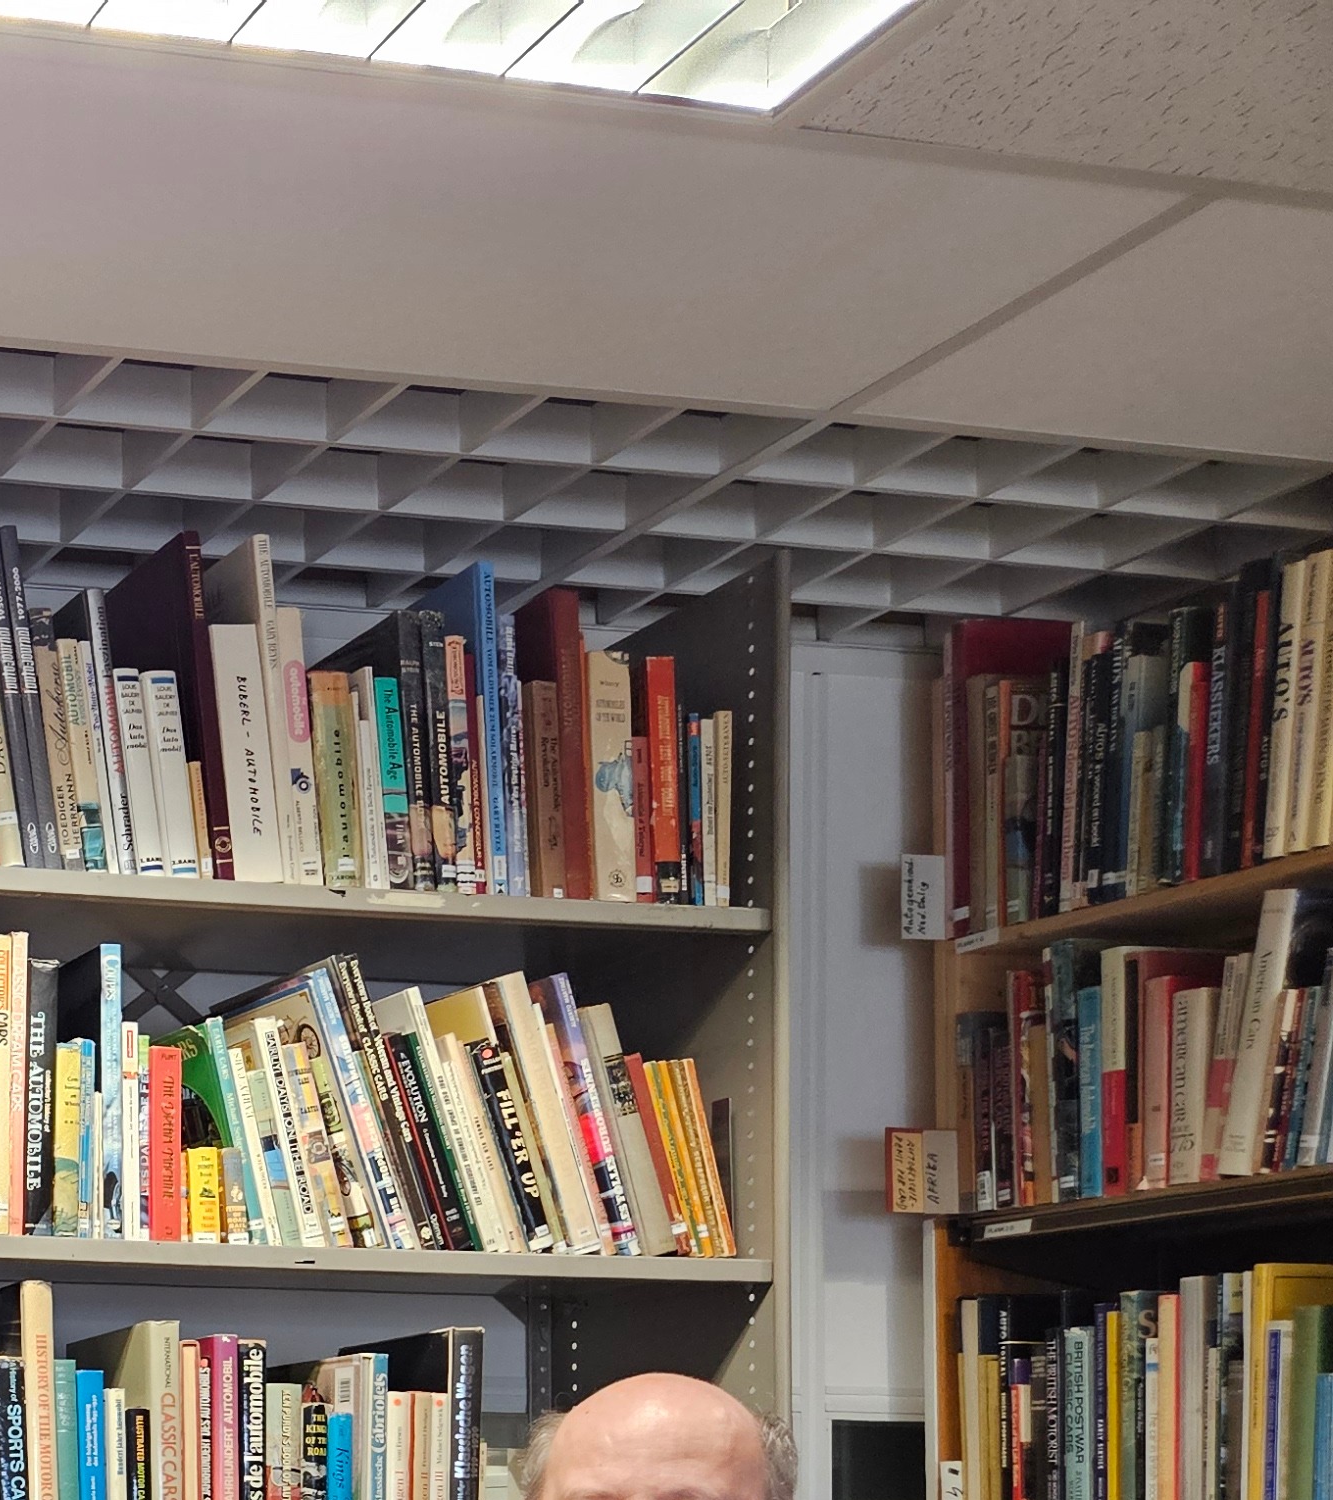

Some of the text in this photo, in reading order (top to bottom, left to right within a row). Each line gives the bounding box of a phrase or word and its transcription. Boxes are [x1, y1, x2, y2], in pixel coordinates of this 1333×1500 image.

[12, 566, 25, 621] 1977-2000
[188, 552, 204, 621] L'AUTOMOBILE
[287, 667, 305, 736] automobile
[1206, 644, 1226, 765] KLASSIEKERS
[1271, 621, 1294, 723] AUTO'S
[236, 675, 252, 725] BUBERL
[245, 748, 262, 837] AUTOMOBILE
[383, 688, 402, 781] The Automobile Age
[435, 710, 451, 804] AUTOMOBILE
[116, 793, 132, 851] Schrader
[1243, 1019, 1263, 1050] Cars
[27, 1012, 46, 1191] THE AUTOMOBILE
[401, 1055, 428, 1122] EVOLUTION
[496, 1089, 518, 1135] FILL
[522, 1168, 540, 1199] UP
[927, 1152, 939, 1206] AFRIKA
[161, 1392, 177, 1461] CLASSIC
[245, 1347, 265, 1462] l'automobile
[454, 1344, 475, 1479] Klassische Wagen
[1047, 1339, 1057, 1464] THE BRITISH MOTORIST
[1065, 1352, 1074, 1454] CLASSIC CARS
[1073, 1340, 1084, 1465] BRITISH POSTWAR
[247, 1465, 264, 1493] de
[335, 1446, 351, 1490] Kings
